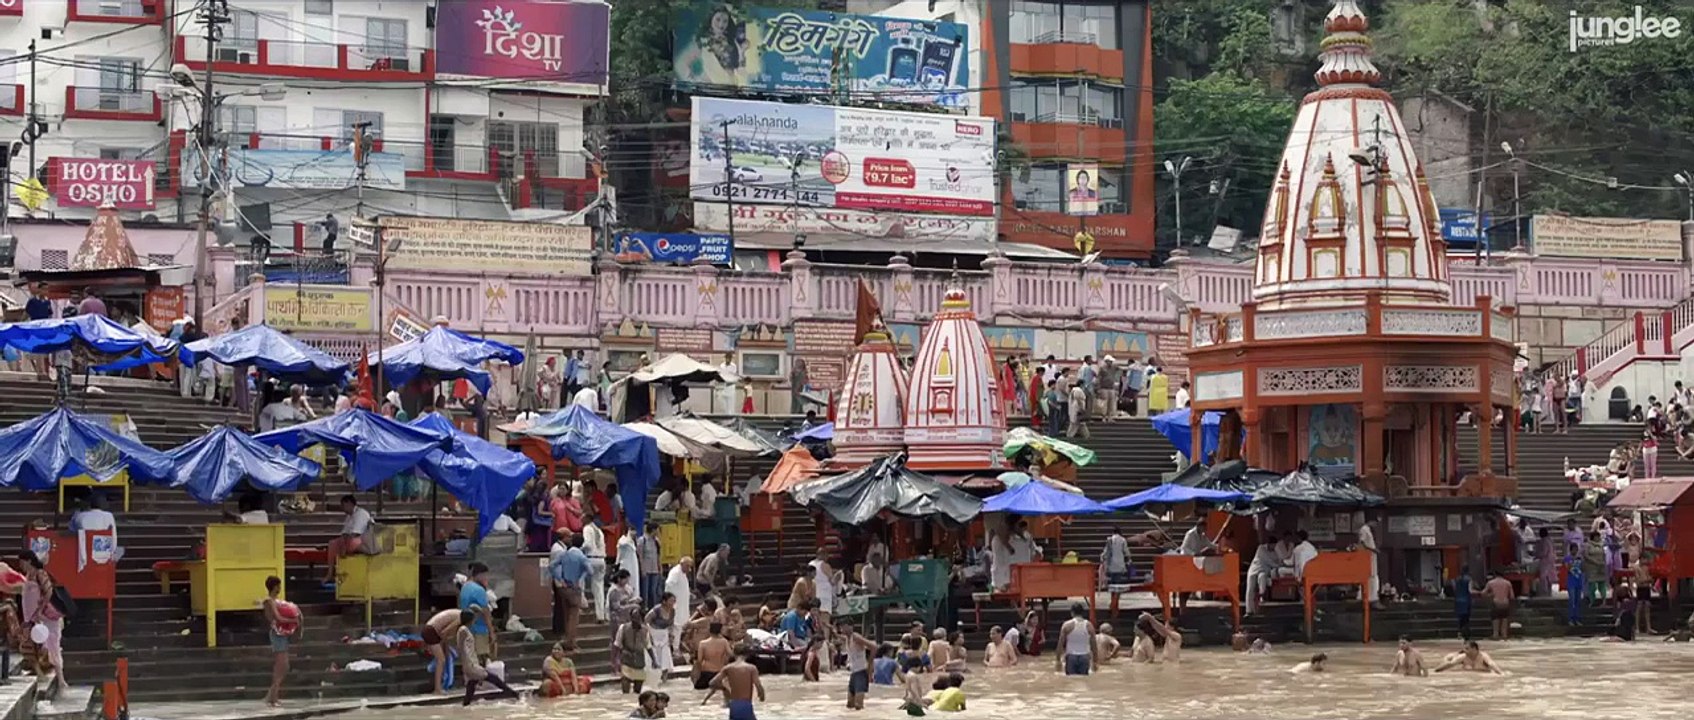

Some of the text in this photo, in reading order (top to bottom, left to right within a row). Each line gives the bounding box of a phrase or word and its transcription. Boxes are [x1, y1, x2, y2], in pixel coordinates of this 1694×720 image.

[480, 10, 564, 59] दिशा
[543, 60, 562, 71] TV
[61, 162, 142, 182] HOTEL
[870, 163, 888, 172] Price
[68, 183, 136, 203] OSHO
[713, 185, 747, 198] 0921
[754, 188, 787, 200] 2771
[700, 236, 728, 245] PAPPU
[670, 243, 694, 254] pepsi
[701, 246, 727, 254] FRUIT
